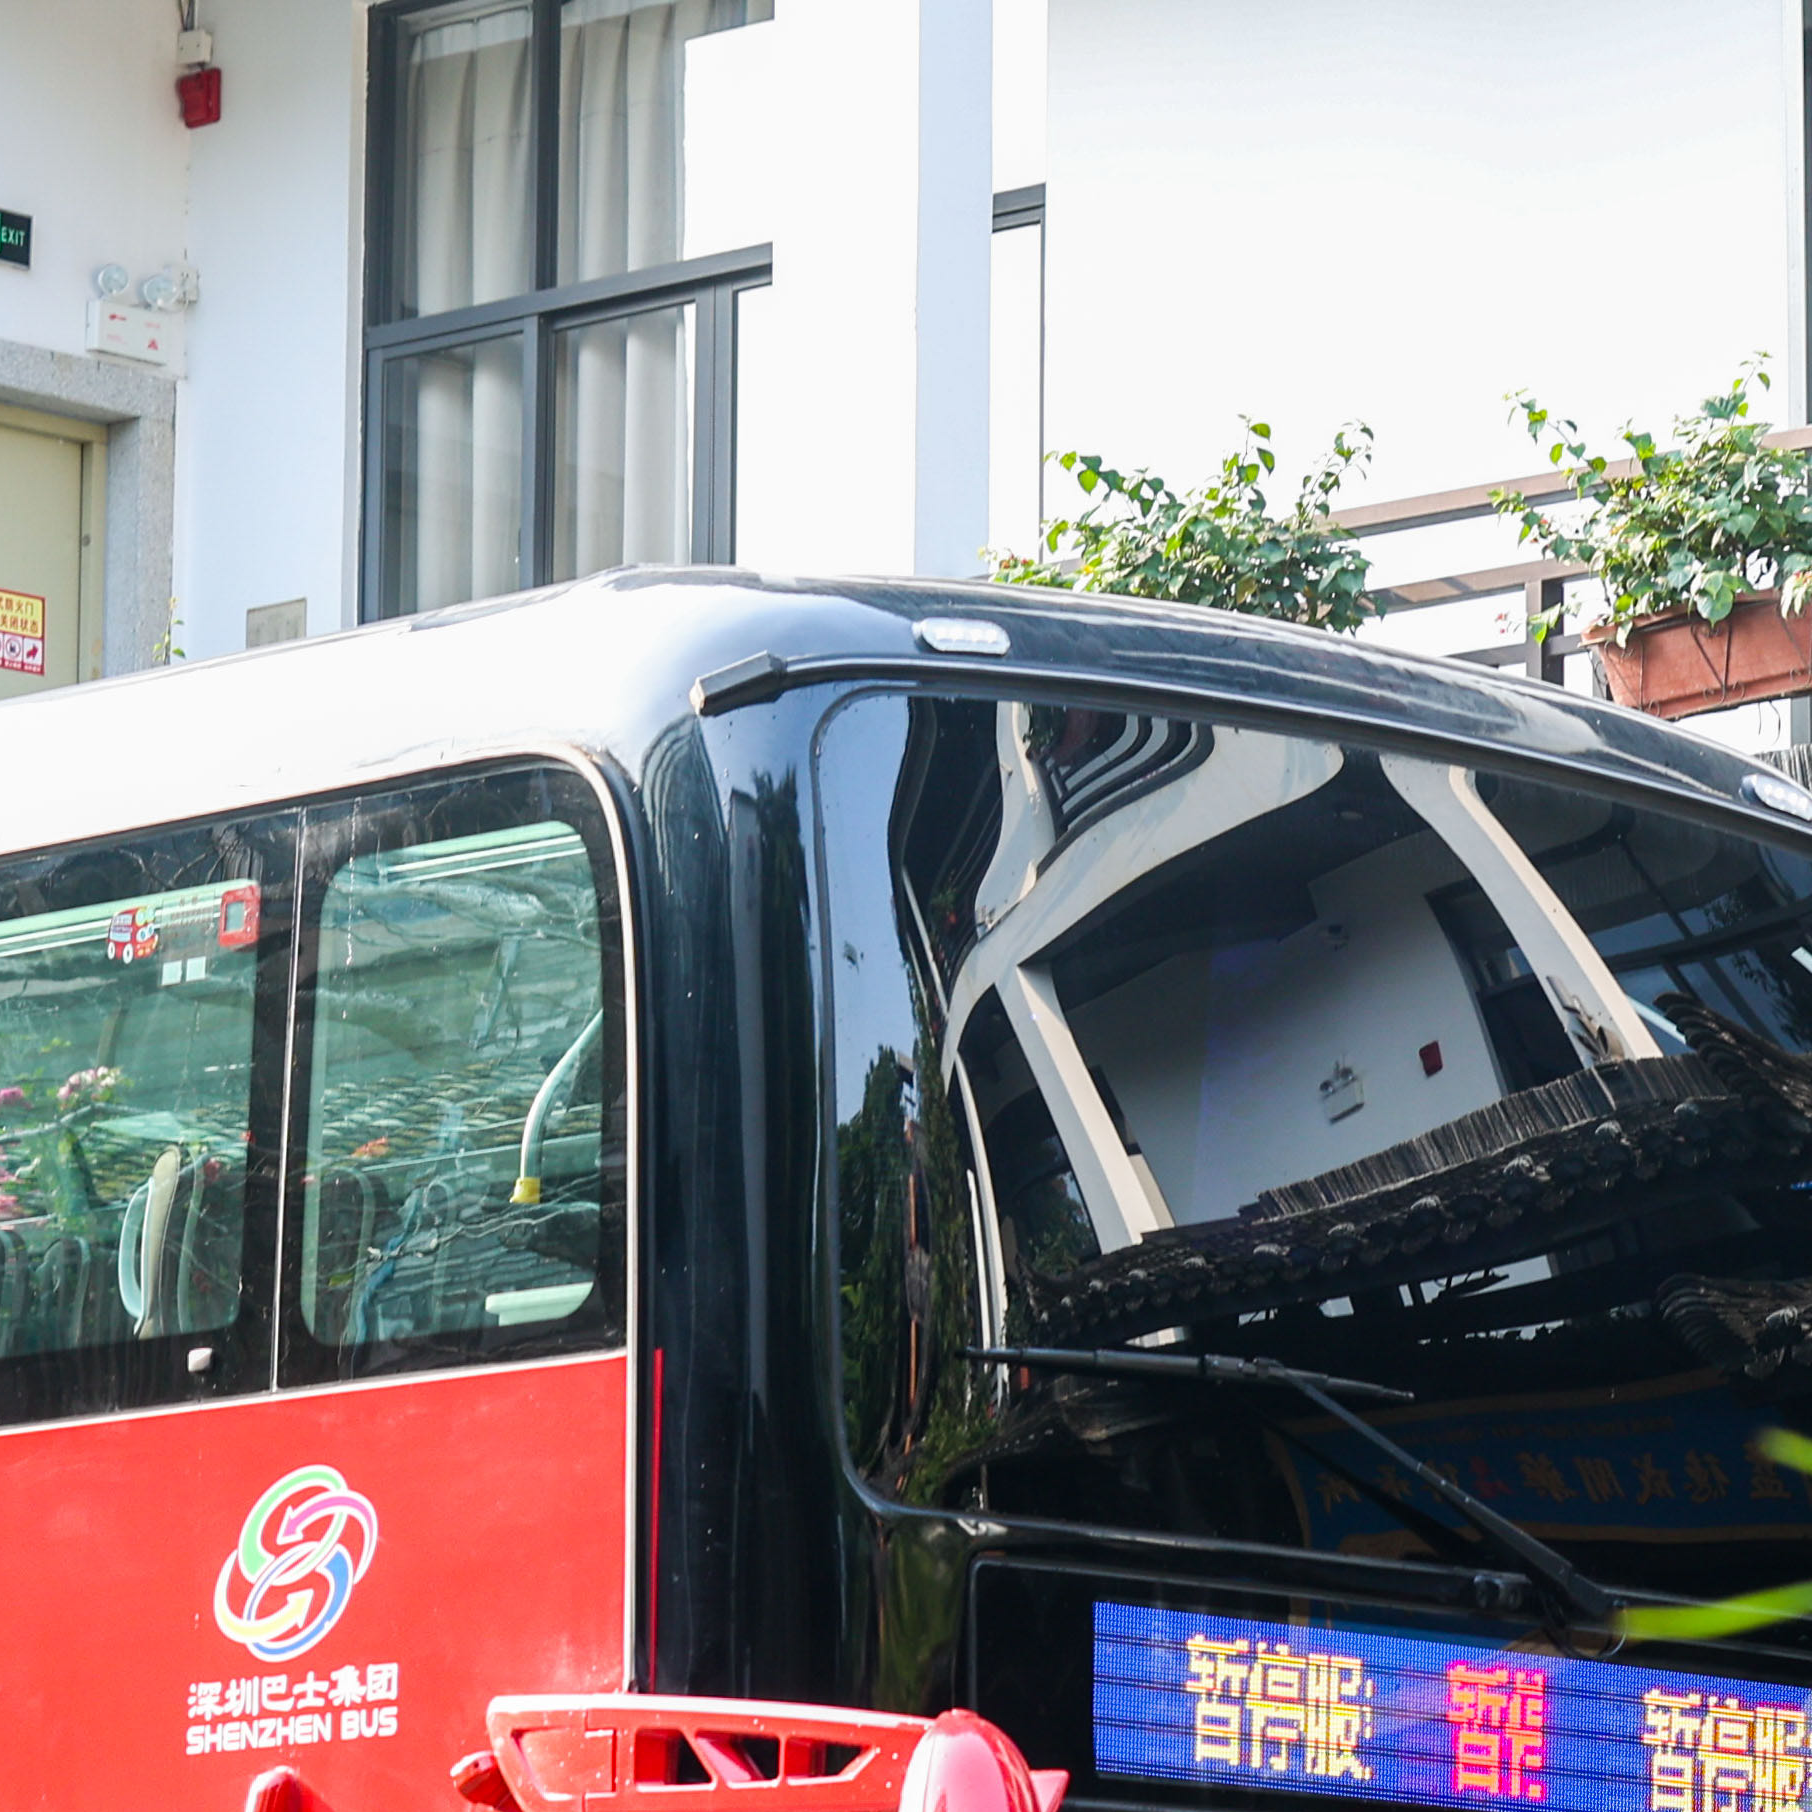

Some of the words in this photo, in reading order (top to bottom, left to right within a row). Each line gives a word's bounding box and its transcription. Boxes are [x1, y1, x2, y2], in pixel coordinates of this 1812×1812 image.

[1, 226, 26, 247] EXIT
[186, 1663, 399, 1720] 深圳巴士集团
[1186, 1634, 1375, 1780] 暂停服
[186, 1714, 331, 1756] SHENZHEN
[339, 1705, 399, 1740] BUS
